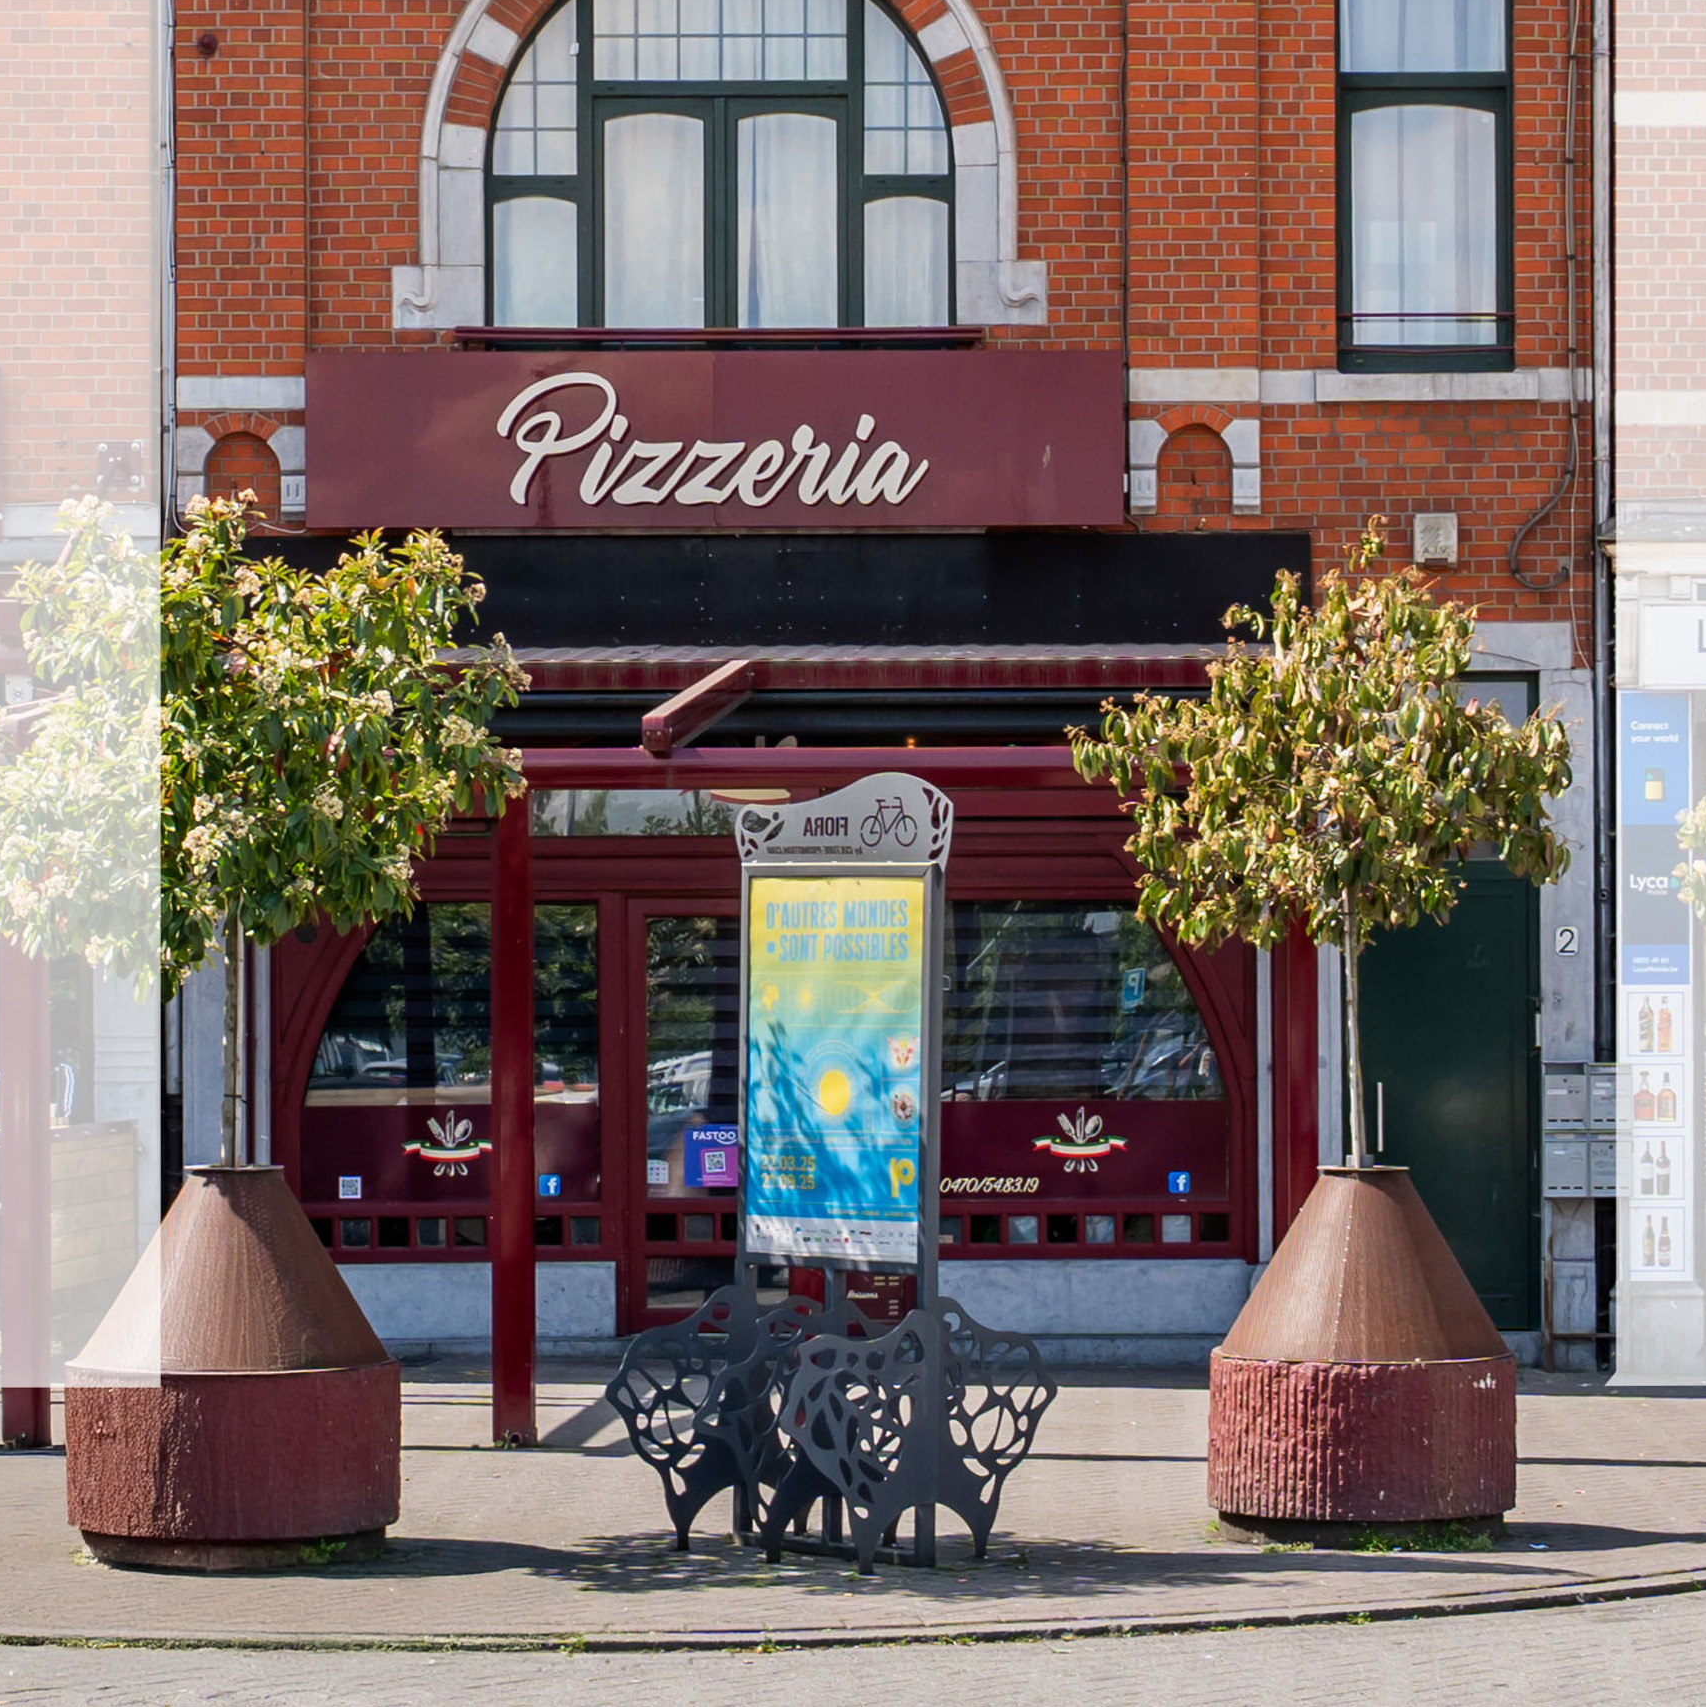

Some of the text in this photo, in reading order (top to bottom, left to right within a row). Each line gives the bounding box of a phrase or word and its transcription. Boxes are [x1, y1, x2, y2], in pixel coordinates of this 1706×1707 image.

[496, 371, 929, 507] Pizzeria
[1630, 720, 1669, 730] Connect
[1630, 733, 1679, 744] your world
[1629, 874, 1668, 892] Lyca
[766, 899, 908, 929] D'AUTRES MONDES
[779, 932, 908, 962] SONT POSSIBLES
[1559, 928, 1575, 953] 2
[693, 1131, 737, 1142] FASTOO
